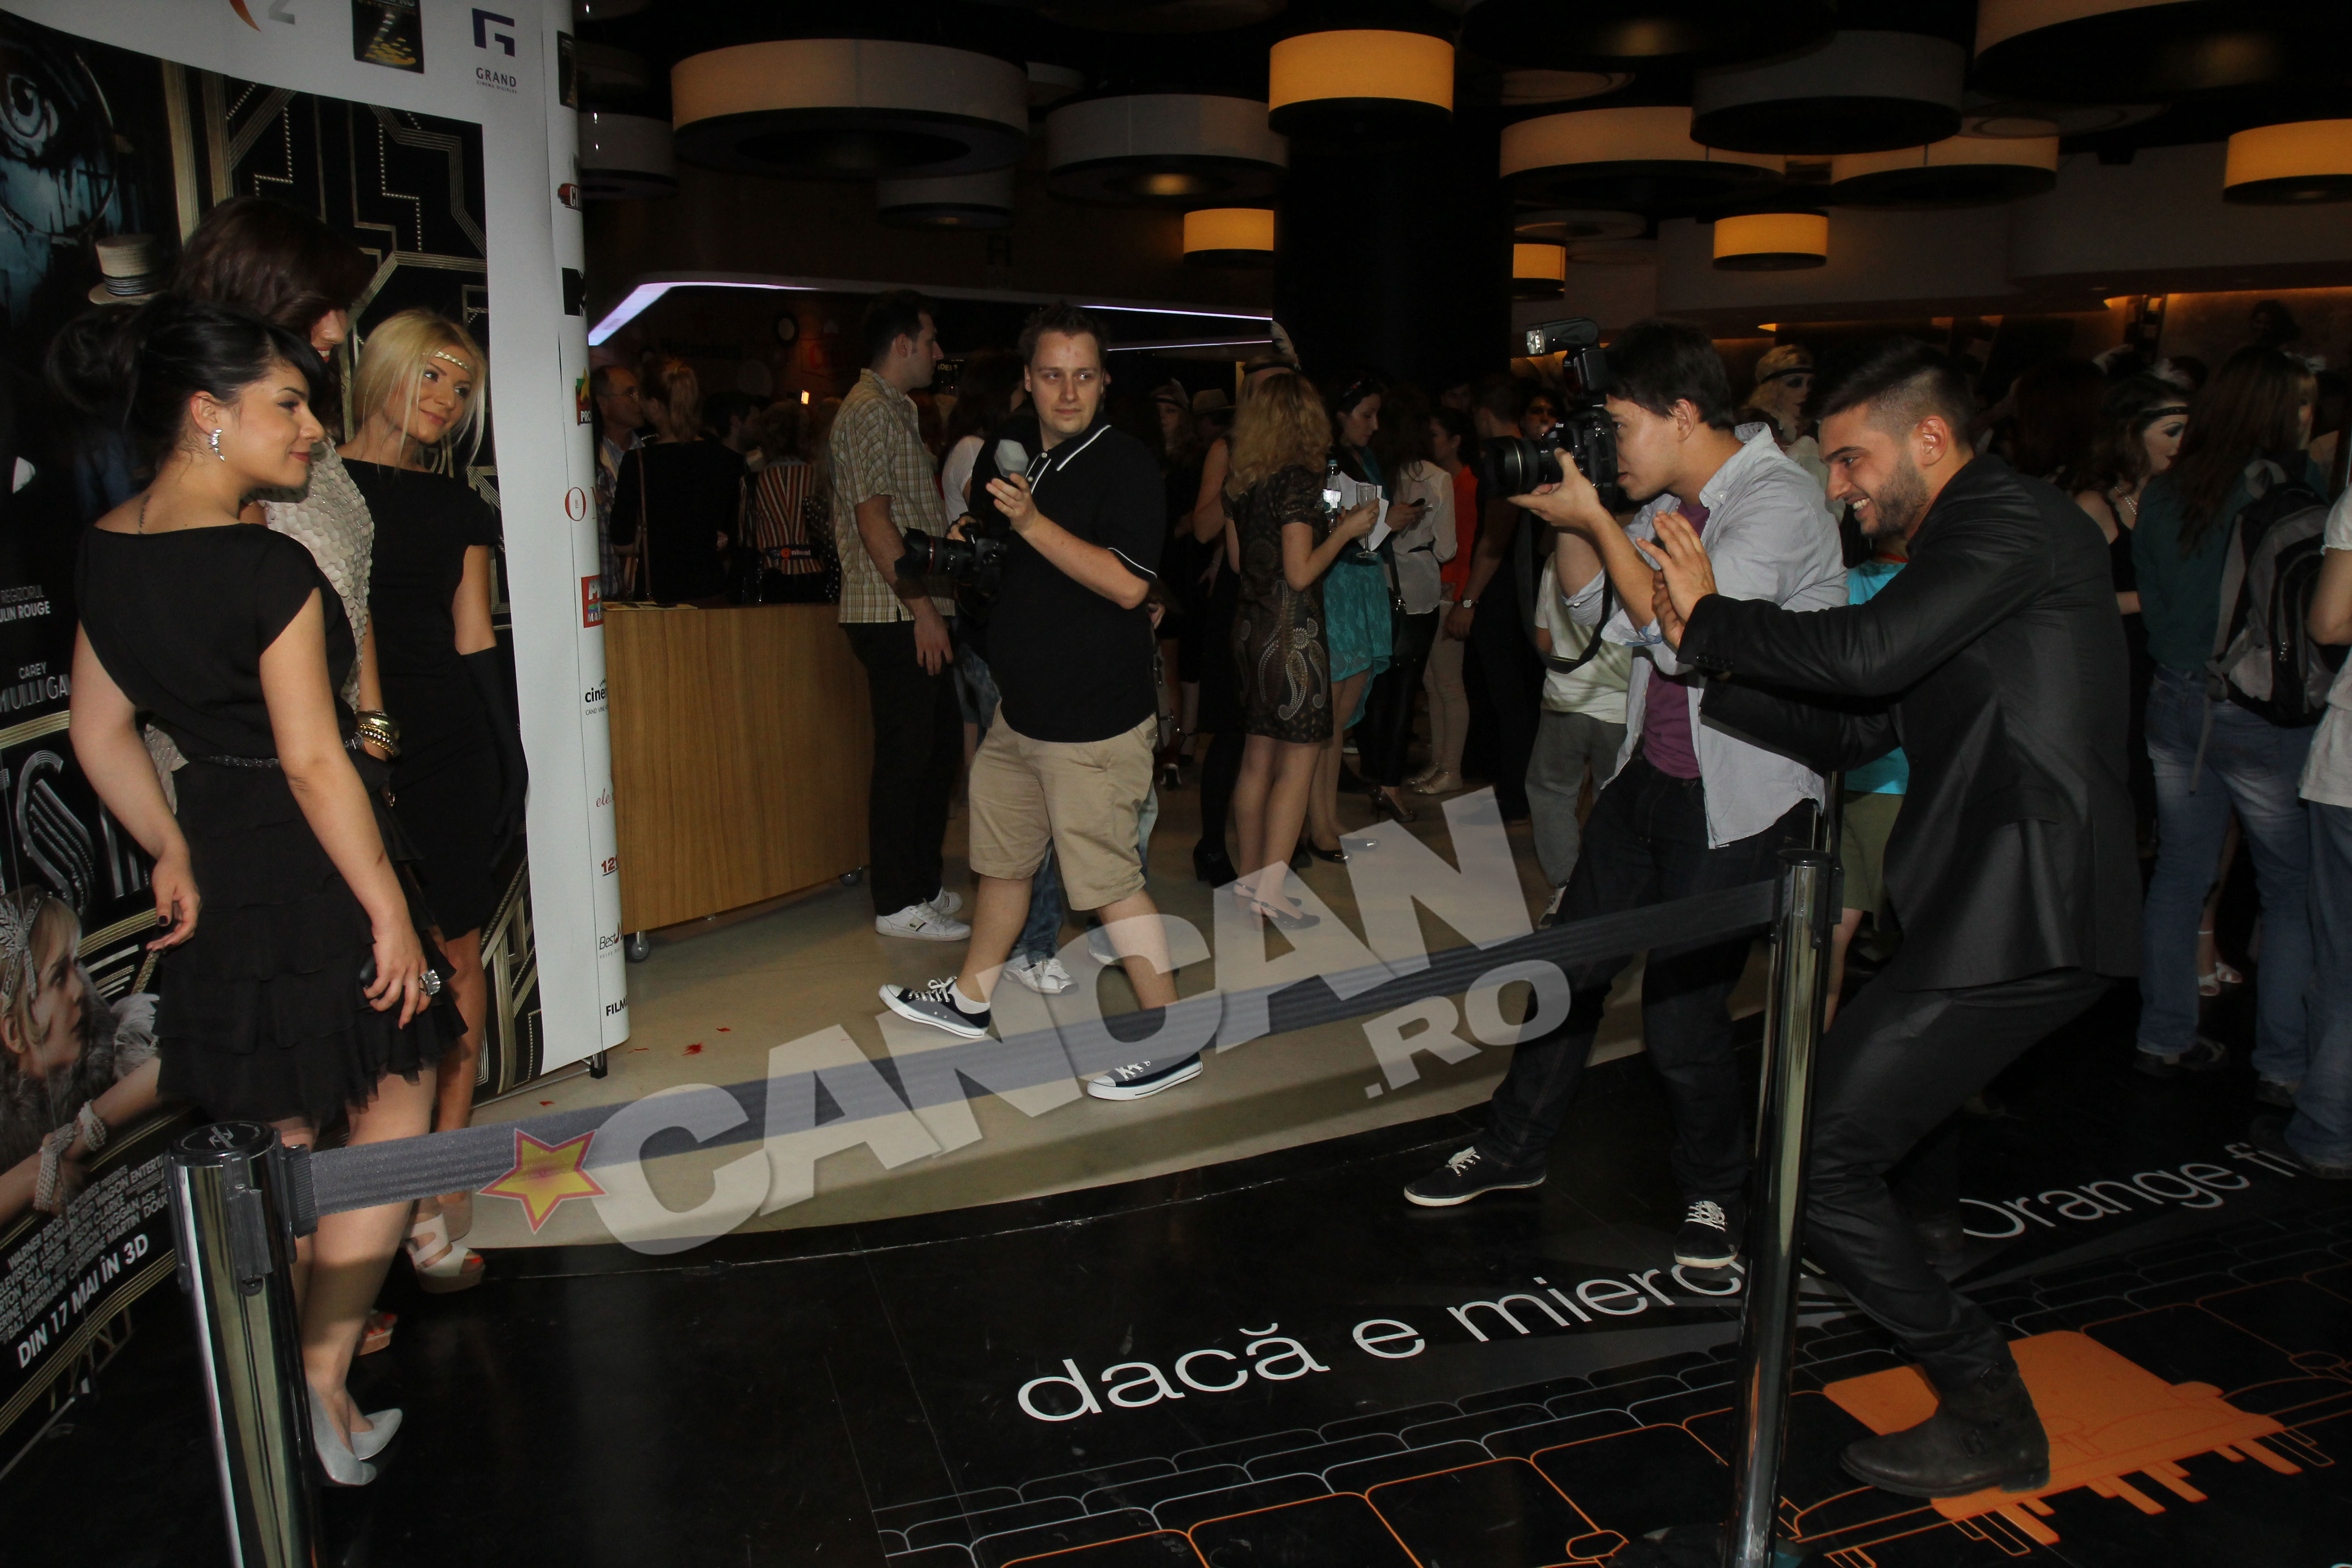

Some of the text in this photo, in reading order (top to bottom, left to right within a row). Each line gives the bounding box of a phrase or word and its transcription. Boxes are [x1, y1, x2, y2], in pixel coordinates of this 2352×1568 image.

[476, 68, 516, 87] GRAND
[18, 601, 50, 619] ROUGE
[19, 662, 46, 679] CAREY
[0, 674, 70, 713] MULLIGA
[92, 1192, 126, 1225] CLARKE
[95, 1175, 129, 1207] WAGON
[100, 1196, 140, 1235] DUGGAN
[106, 1210, 141, 1245] MARTIN
[6, 1232, 43, 1270] WARNER
[17, 1323, 49, 1369] DIN
[51, 1300, 69, 1334] 17
[71, 1270, 100, 1313] MAI
[99, 1252, 121, 1284] ÎN
[123, 1234, 149, 1264] 3D
[1017, 1262, 1745, 1422] dacă e mierc
